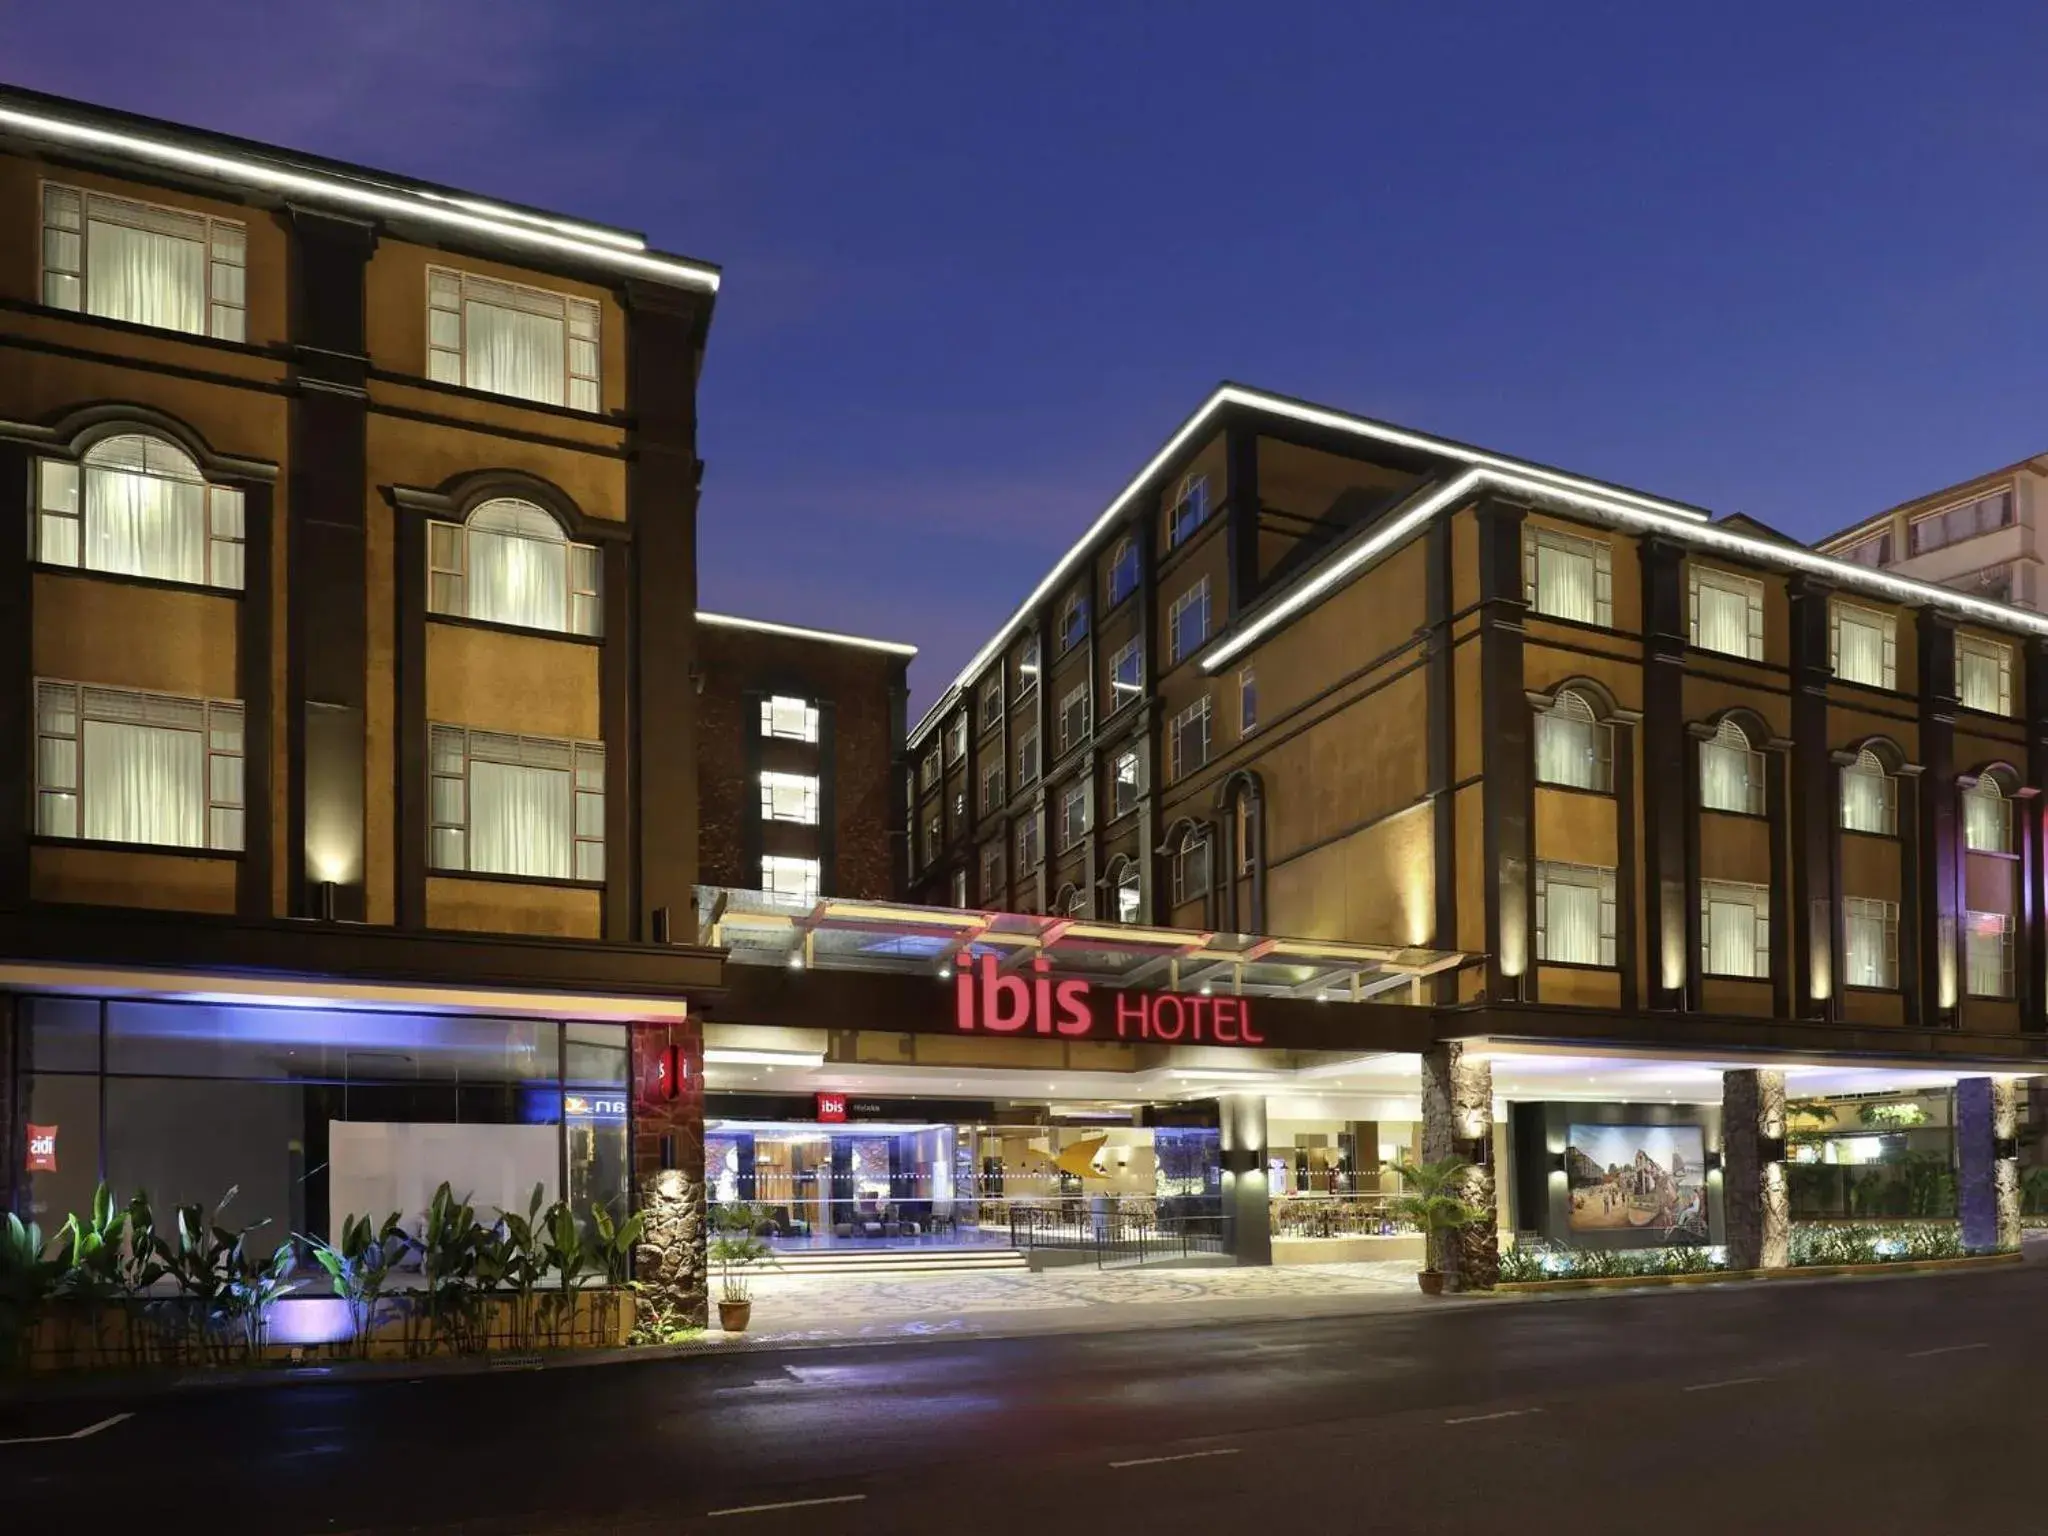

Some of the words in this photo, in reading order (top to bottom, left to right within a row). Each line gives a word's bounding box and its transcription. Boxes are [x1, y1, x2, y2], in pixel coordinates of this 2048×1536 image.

[955, 952, 1093, 1036] ibis
[1117, 992, 1264, 1043] HOTEL
[821, 1099, 844, 1113] ibis
